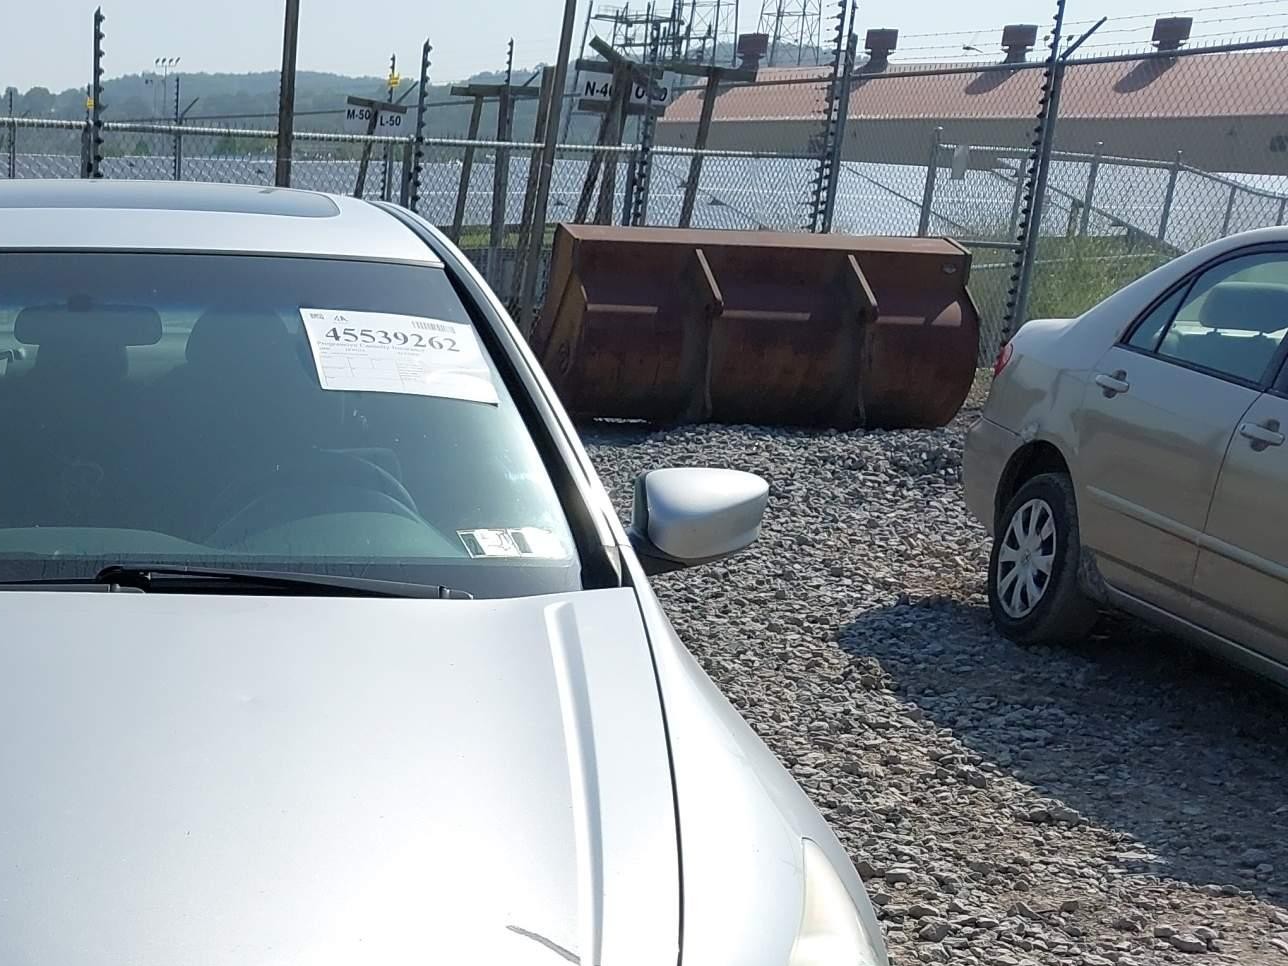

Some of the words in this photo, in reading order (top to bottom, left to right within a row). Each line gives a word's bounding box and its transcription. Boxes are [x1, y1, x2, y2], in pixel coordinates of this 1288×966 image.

[584, 80, 613, 97] N-4
[346, 108, 371, 120] M-50
[379, 115, 402, 127] L-50
[325, 327, 460, 352] 45539262
